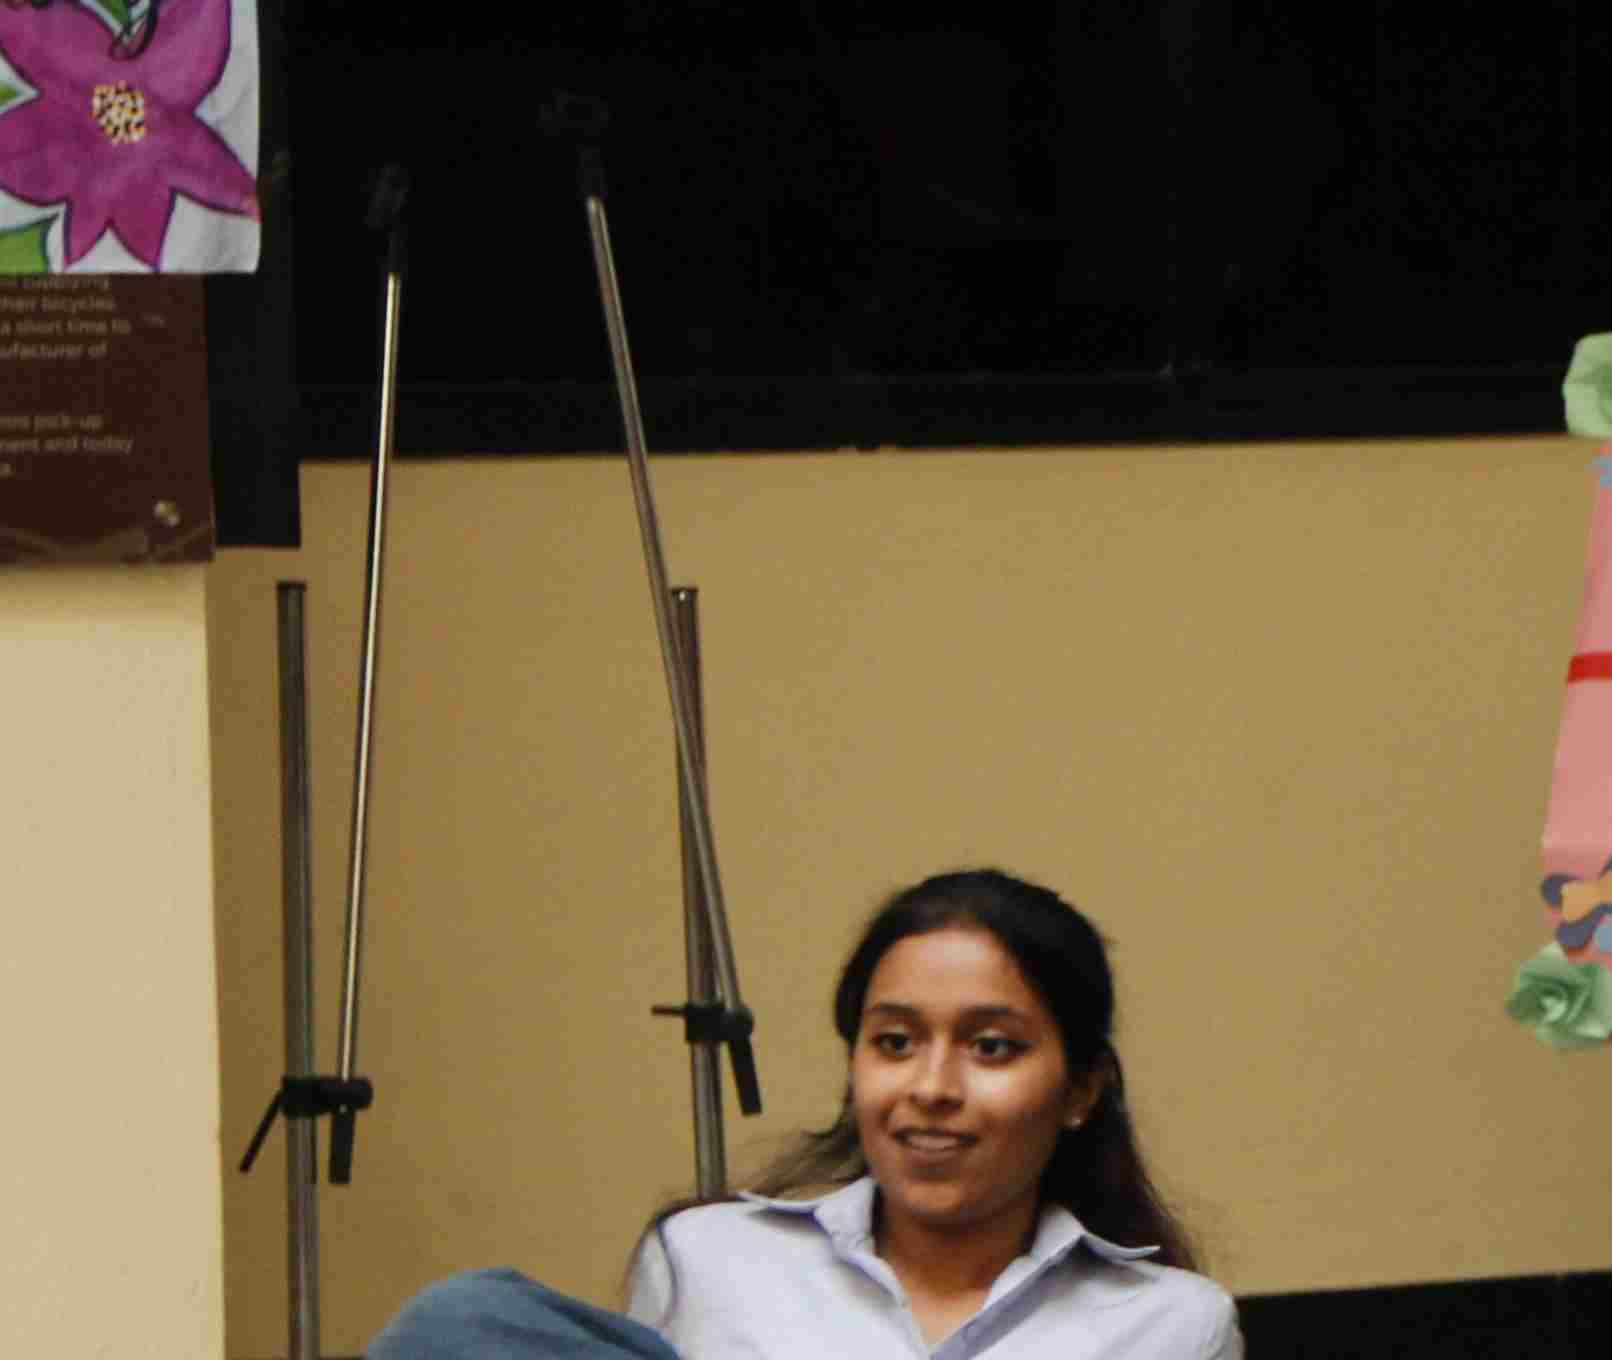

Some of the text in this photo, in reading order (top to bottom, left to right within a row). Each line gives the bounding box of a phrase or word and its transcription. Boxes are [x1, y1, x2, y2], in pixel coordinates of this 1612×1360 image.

[15, 319, 62, 335] short
[67, 319, 107, 335] time
[112, 319, 132, 335] to
[88, 340, 108, 359] of
[45, 436, 78, 452] and
[83, 436, 133, 455] today
